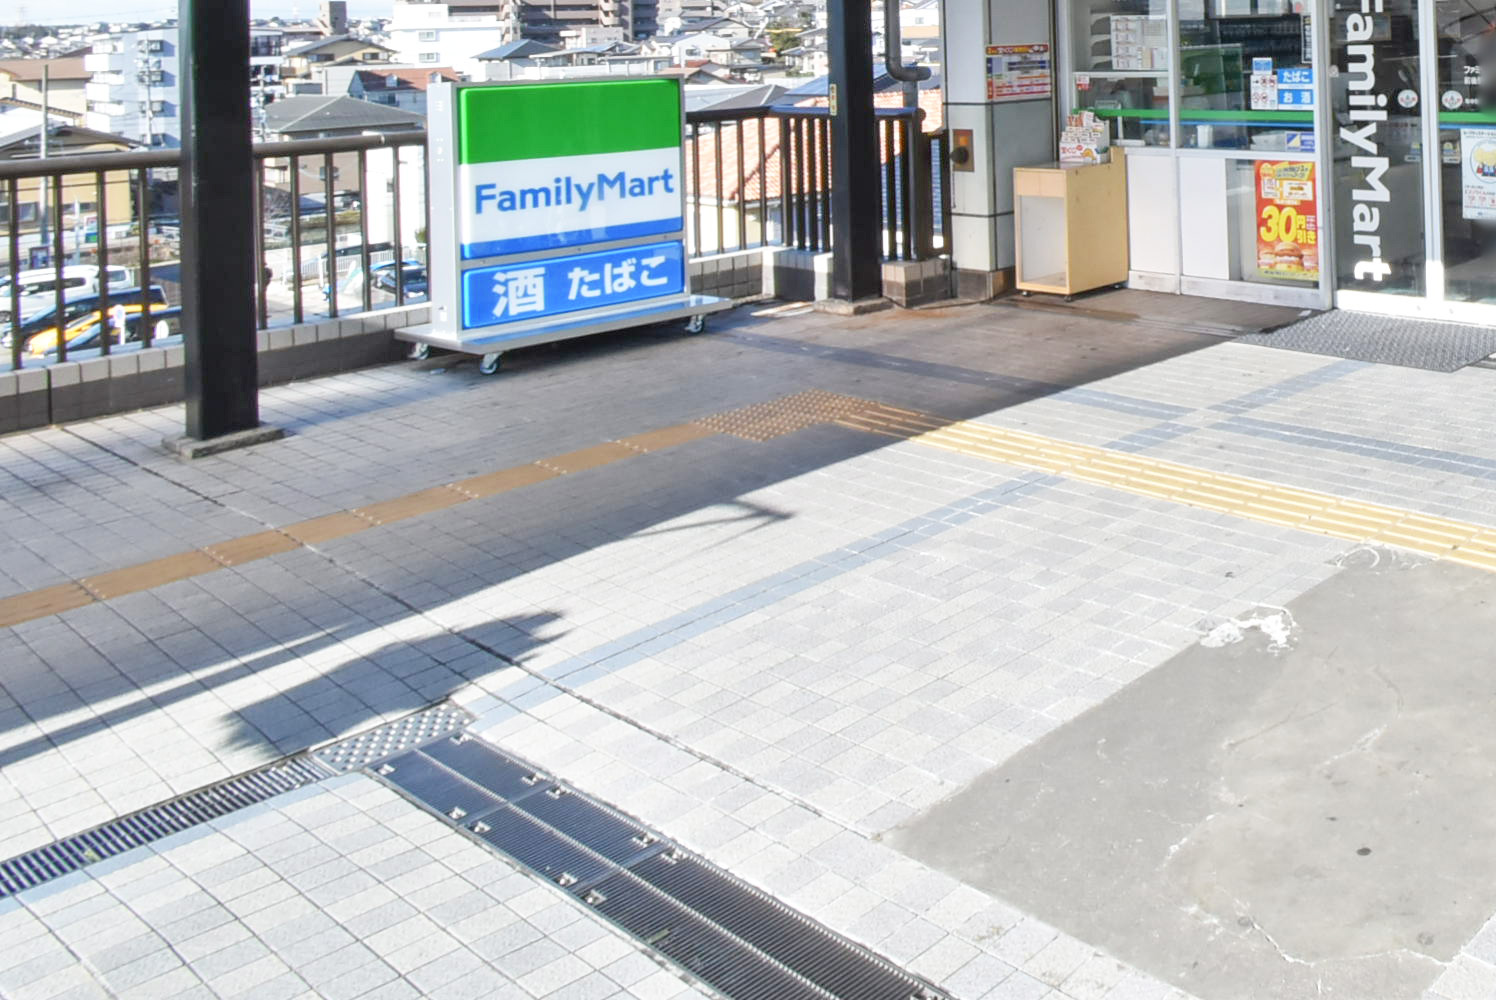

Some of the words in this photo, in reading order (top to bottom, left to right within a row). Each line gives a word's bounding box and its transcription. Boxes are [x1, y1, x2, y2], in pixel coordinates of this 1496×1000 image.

[1283, 70, 1310, 83] たばこ
[475, 168, 674, 215] FamilyMart
[492, 266, 546, 317] 酒
[567, 256, 668, 300] たばこ
